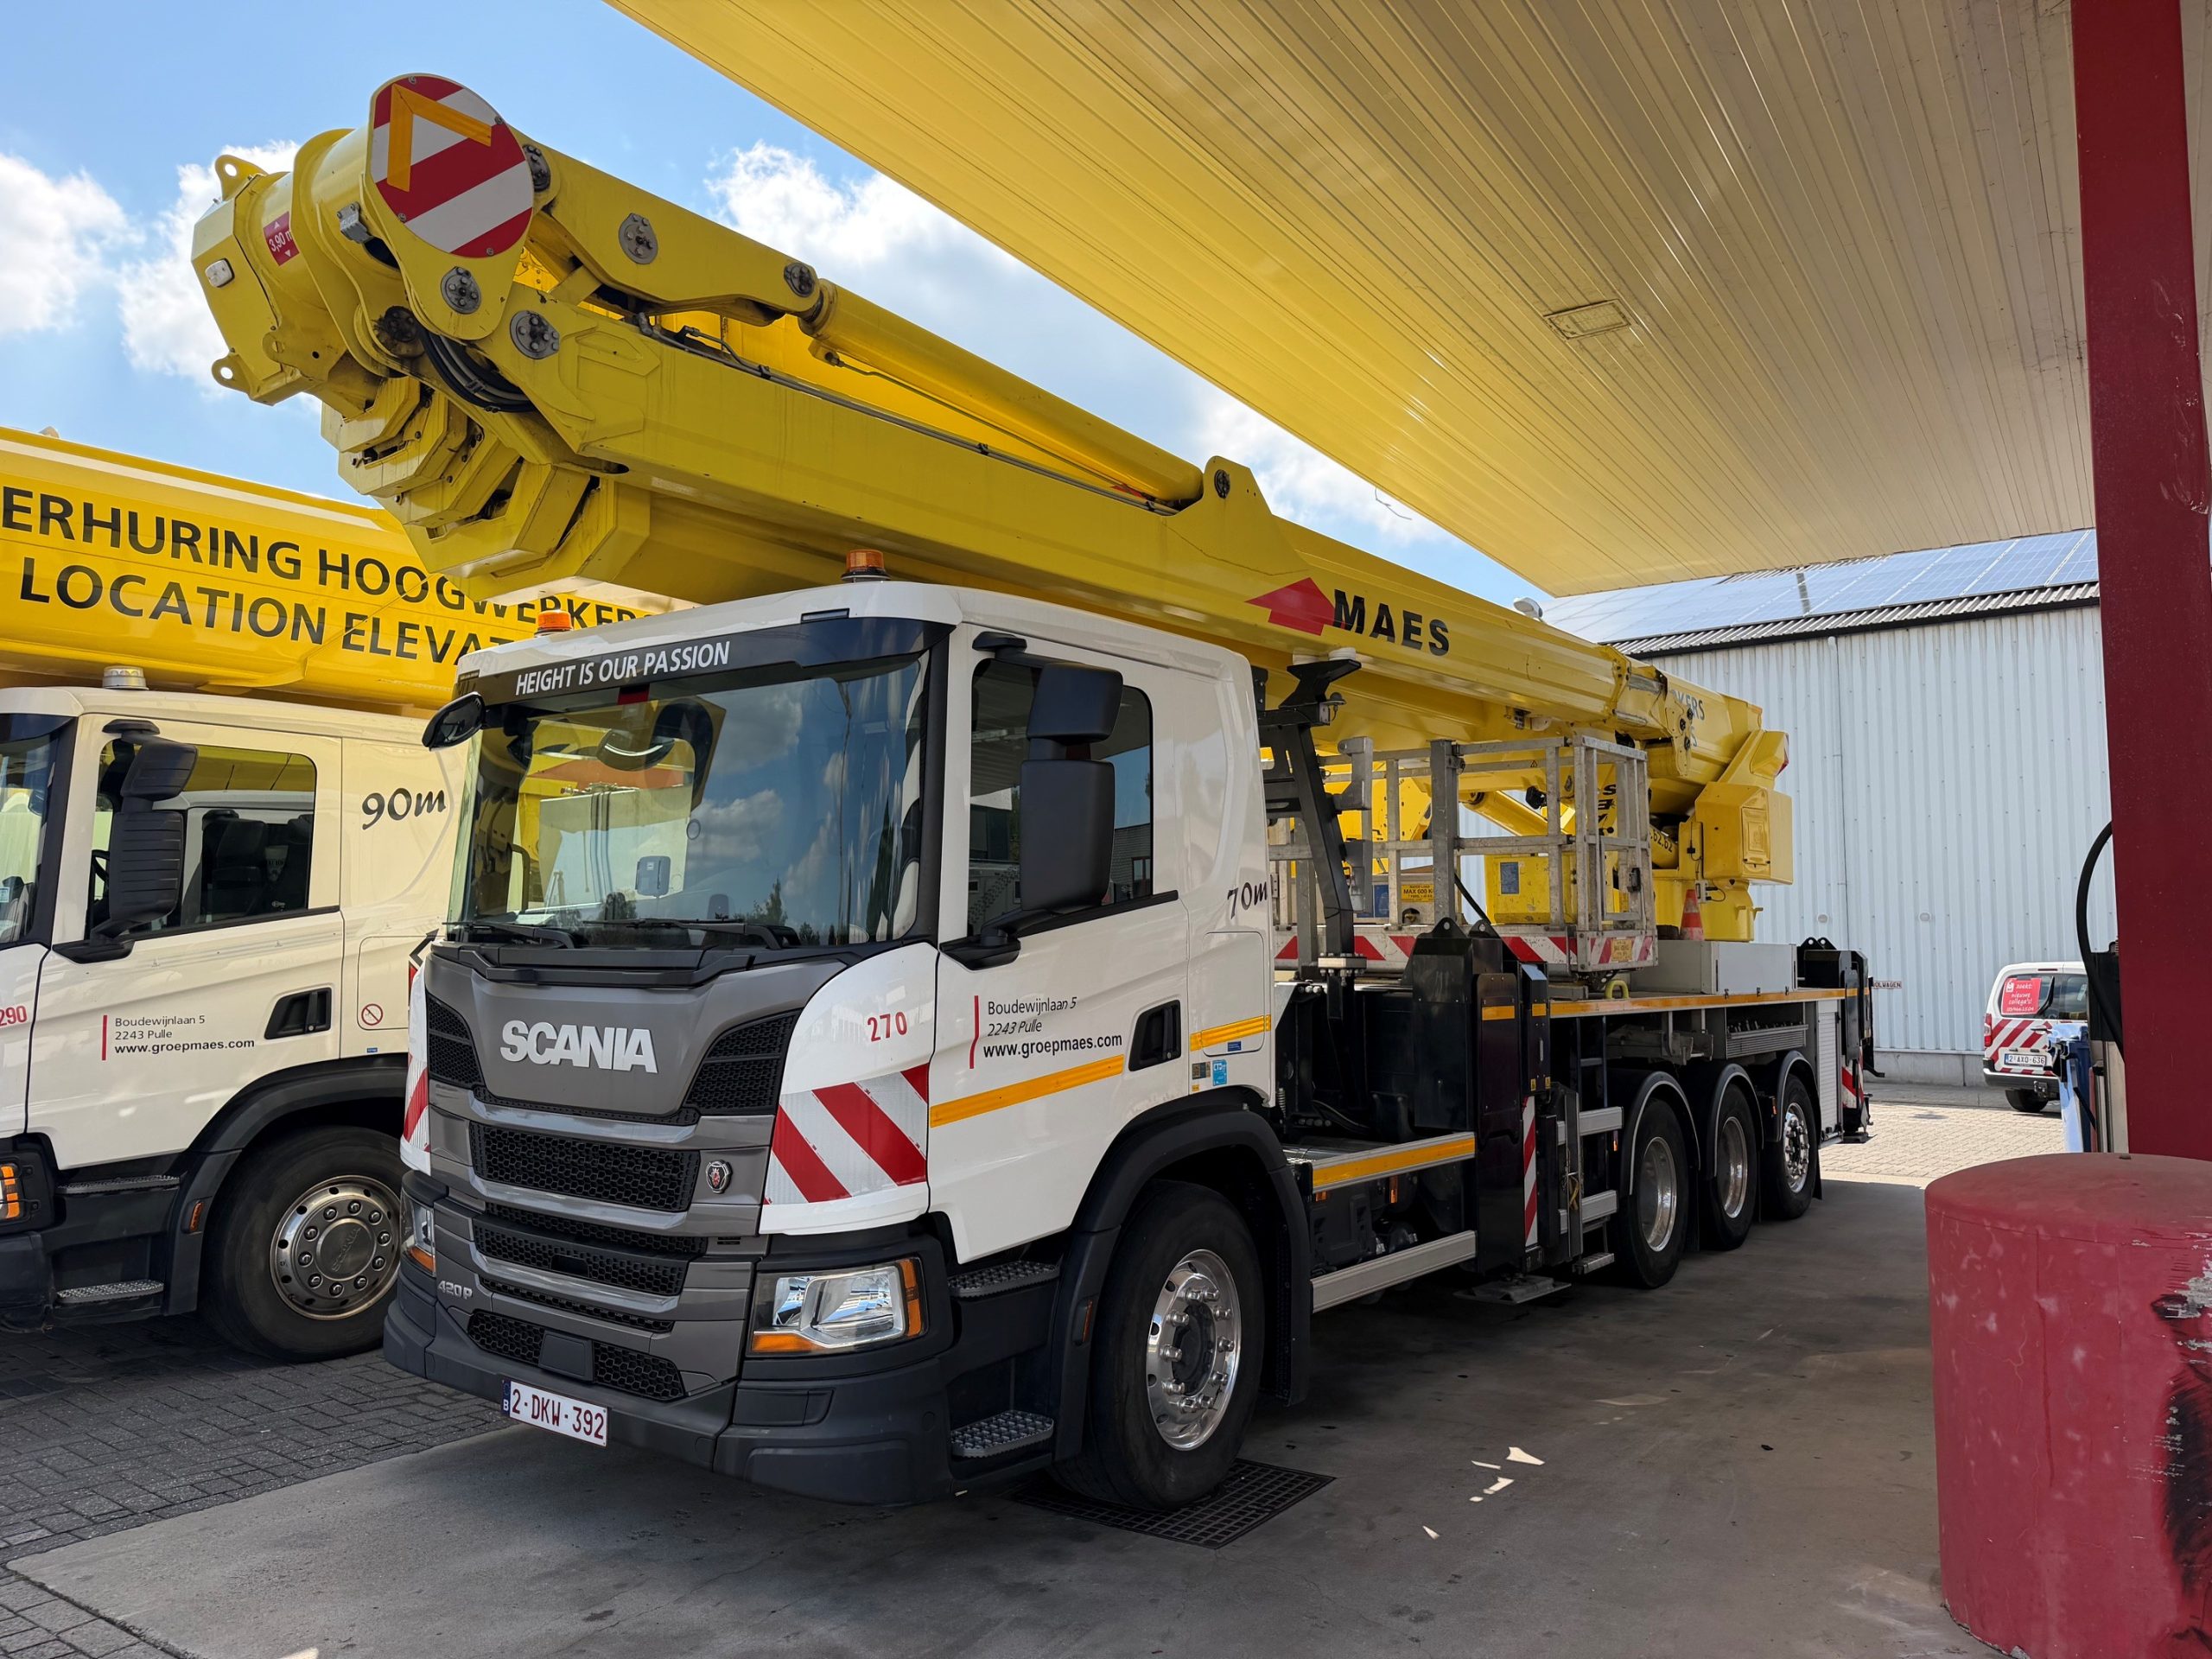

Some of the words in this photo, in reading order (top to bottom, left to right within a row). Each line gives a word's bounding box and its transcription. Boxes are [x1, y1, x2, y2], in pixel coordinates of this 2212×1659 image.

[20, 557, 327, 645] LOCATION
[1332, 588, 1450, 657] MAES
[515, 664, 576, 696] HEIGHT
[578, 661, 595, 686] IS
[598, 654, 639, 683] OUR
[643, 640, 731, 676] PASSION
[361, 787, 447, 830] 90m
[1227, 881, 1268, 920] 70m
[988, 997, 1069, 1016] Boudewijnlaan
[1069, 996, 1077, 1010] 5
[114, 1030, 145, 1040] 2243
[147, 1029, 173, 1039] Pulle
[115, 1015, 196, 1029] Boudewijnlaan
[198, 1014, 206, 1025] 5
[867, 1011, 908, 1042] 270
[987, 1021, 1017, 1038] 2243
[1017, 1018, 1043, 1034] Pulle
[114, 1039, 256, 1054] www.groepmaes.com
[499, 1020, 658, 1074] SCANIA
[982, 1033, 1122, 1059] www.groepmaes.com
[503, 1399, 509, 1411] B
